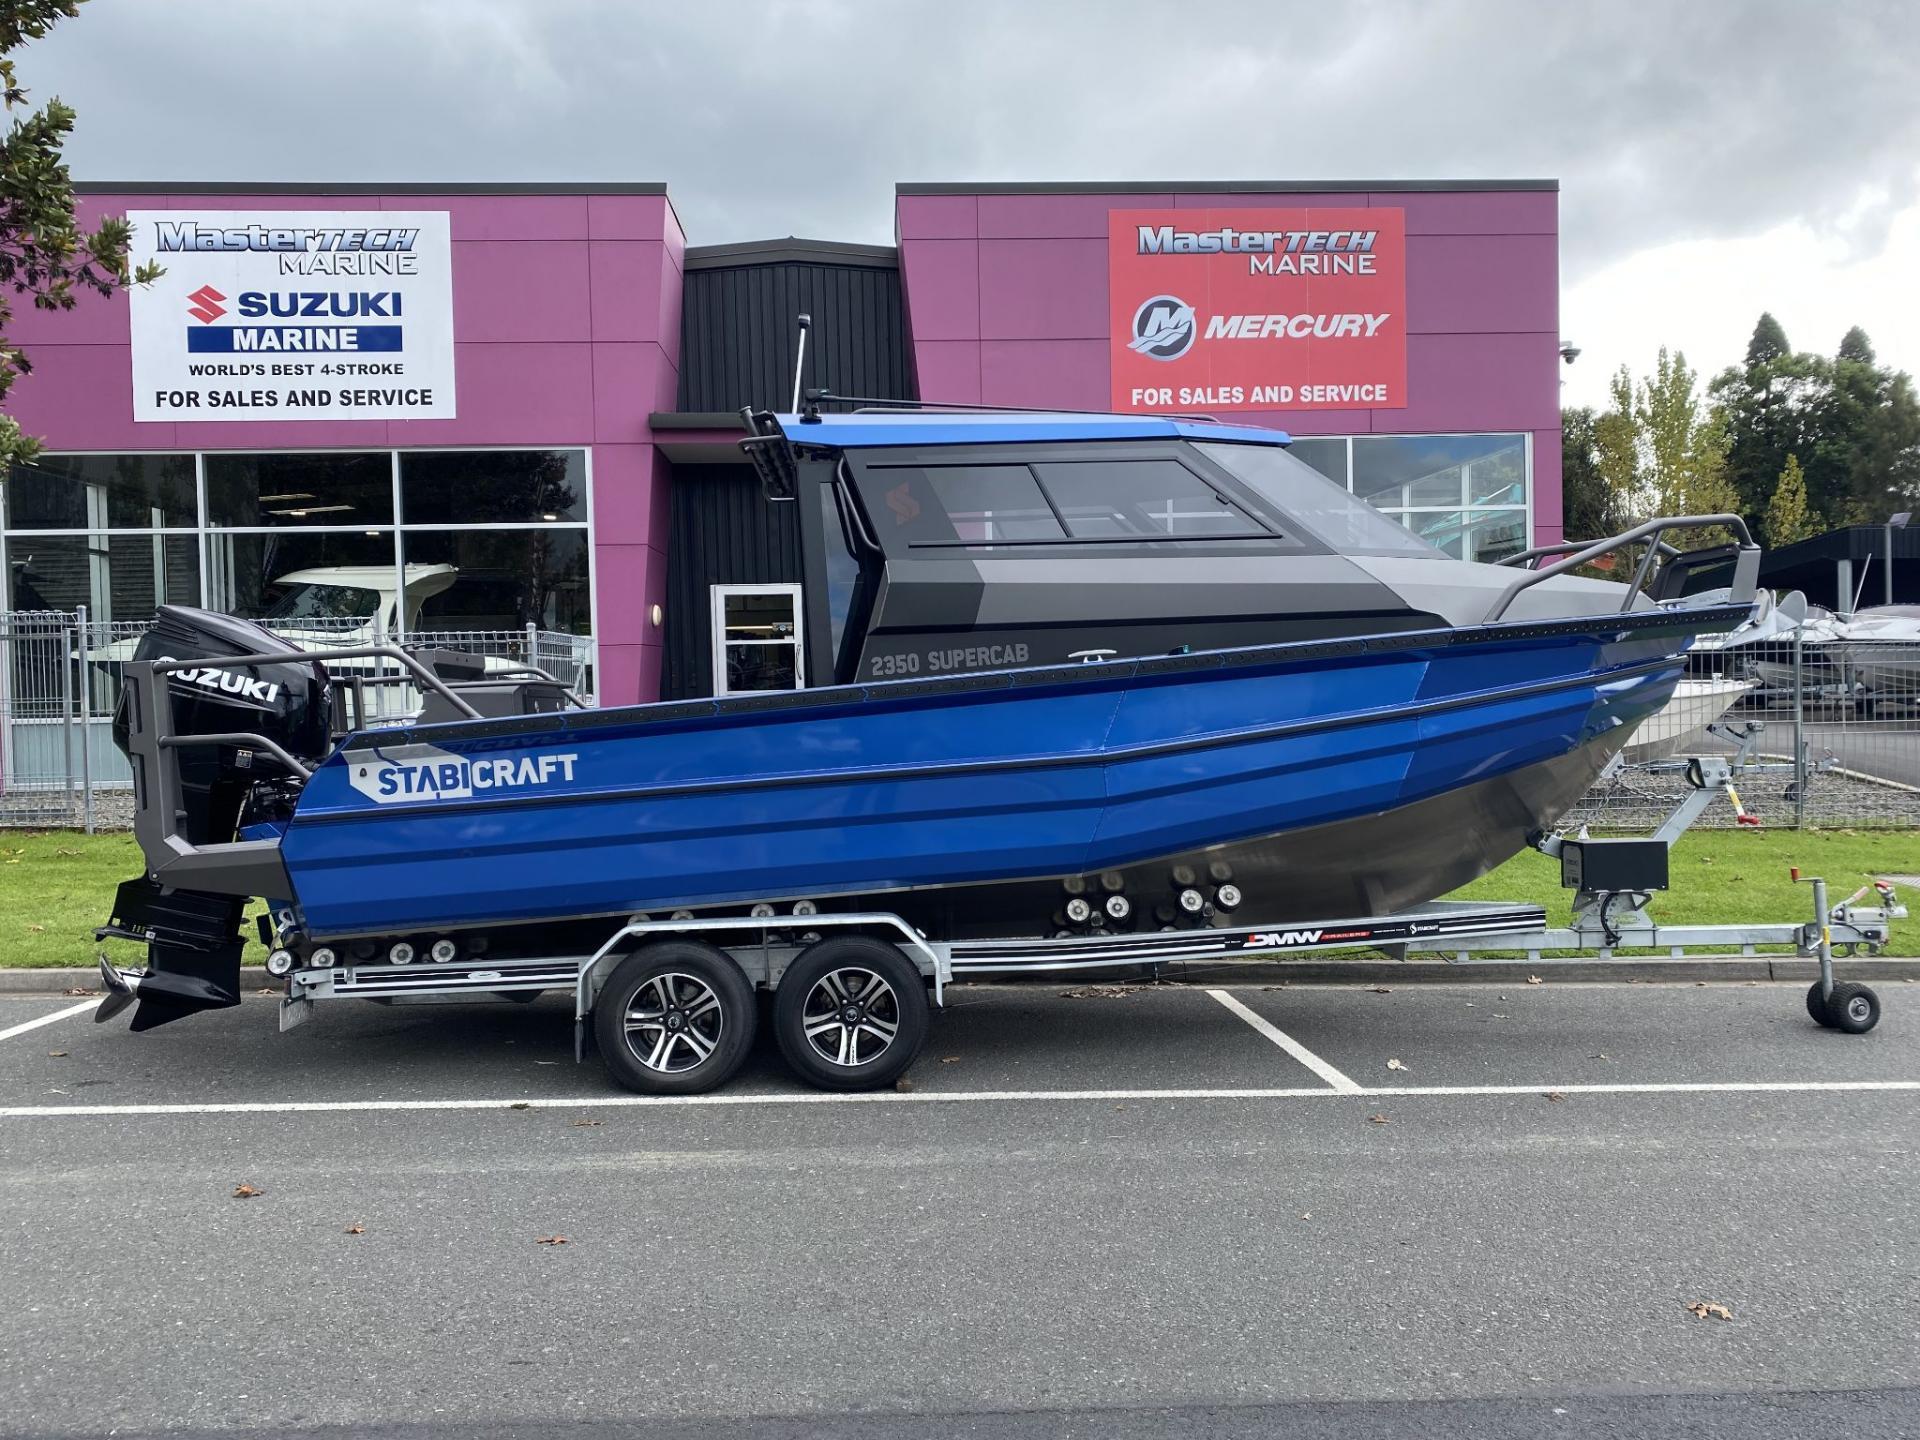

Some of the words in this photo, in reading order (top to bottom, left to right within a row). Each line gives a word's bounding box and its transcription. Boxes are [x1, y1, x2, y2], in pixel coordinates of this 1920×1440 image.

[154, 221, 420, 252] MasterTECH
[1137, 226, 1379, 255] MasterTECH
[279, 252, 418, 275] MARINE
[1250, 254, 1377, 276] MARINE
[238, 292, 401, 317] SUZUKI
[1204, 313, 1391, 339] MERCURY
[232, 328, 359, 351] MARINE
[189, 364, 266, 376] WORLD'S
[271, 364, 315, 376] BEST
[320, 363, 404, 376] 4-STROKE
[156, 391, 200, 408] FOR
[207, 390, 280, 408] SALES
[285, 389, 332, 407] AND
[339, 388, 433, 407] SERVICE
[1132, 388, 1173, 406] FOR
[1179, 387, 1244, 405] SALES
[1250, 386, 1294, 403] AND
[1300, 384, 1387, 402] SERVICE
[871, 653, 920, 676] 2350
[927, 643, 1030, 671] SUPERCAB
[378, 753, 578, 796] STABICRAFT
[1243, 930, 1323, 948] DMW
